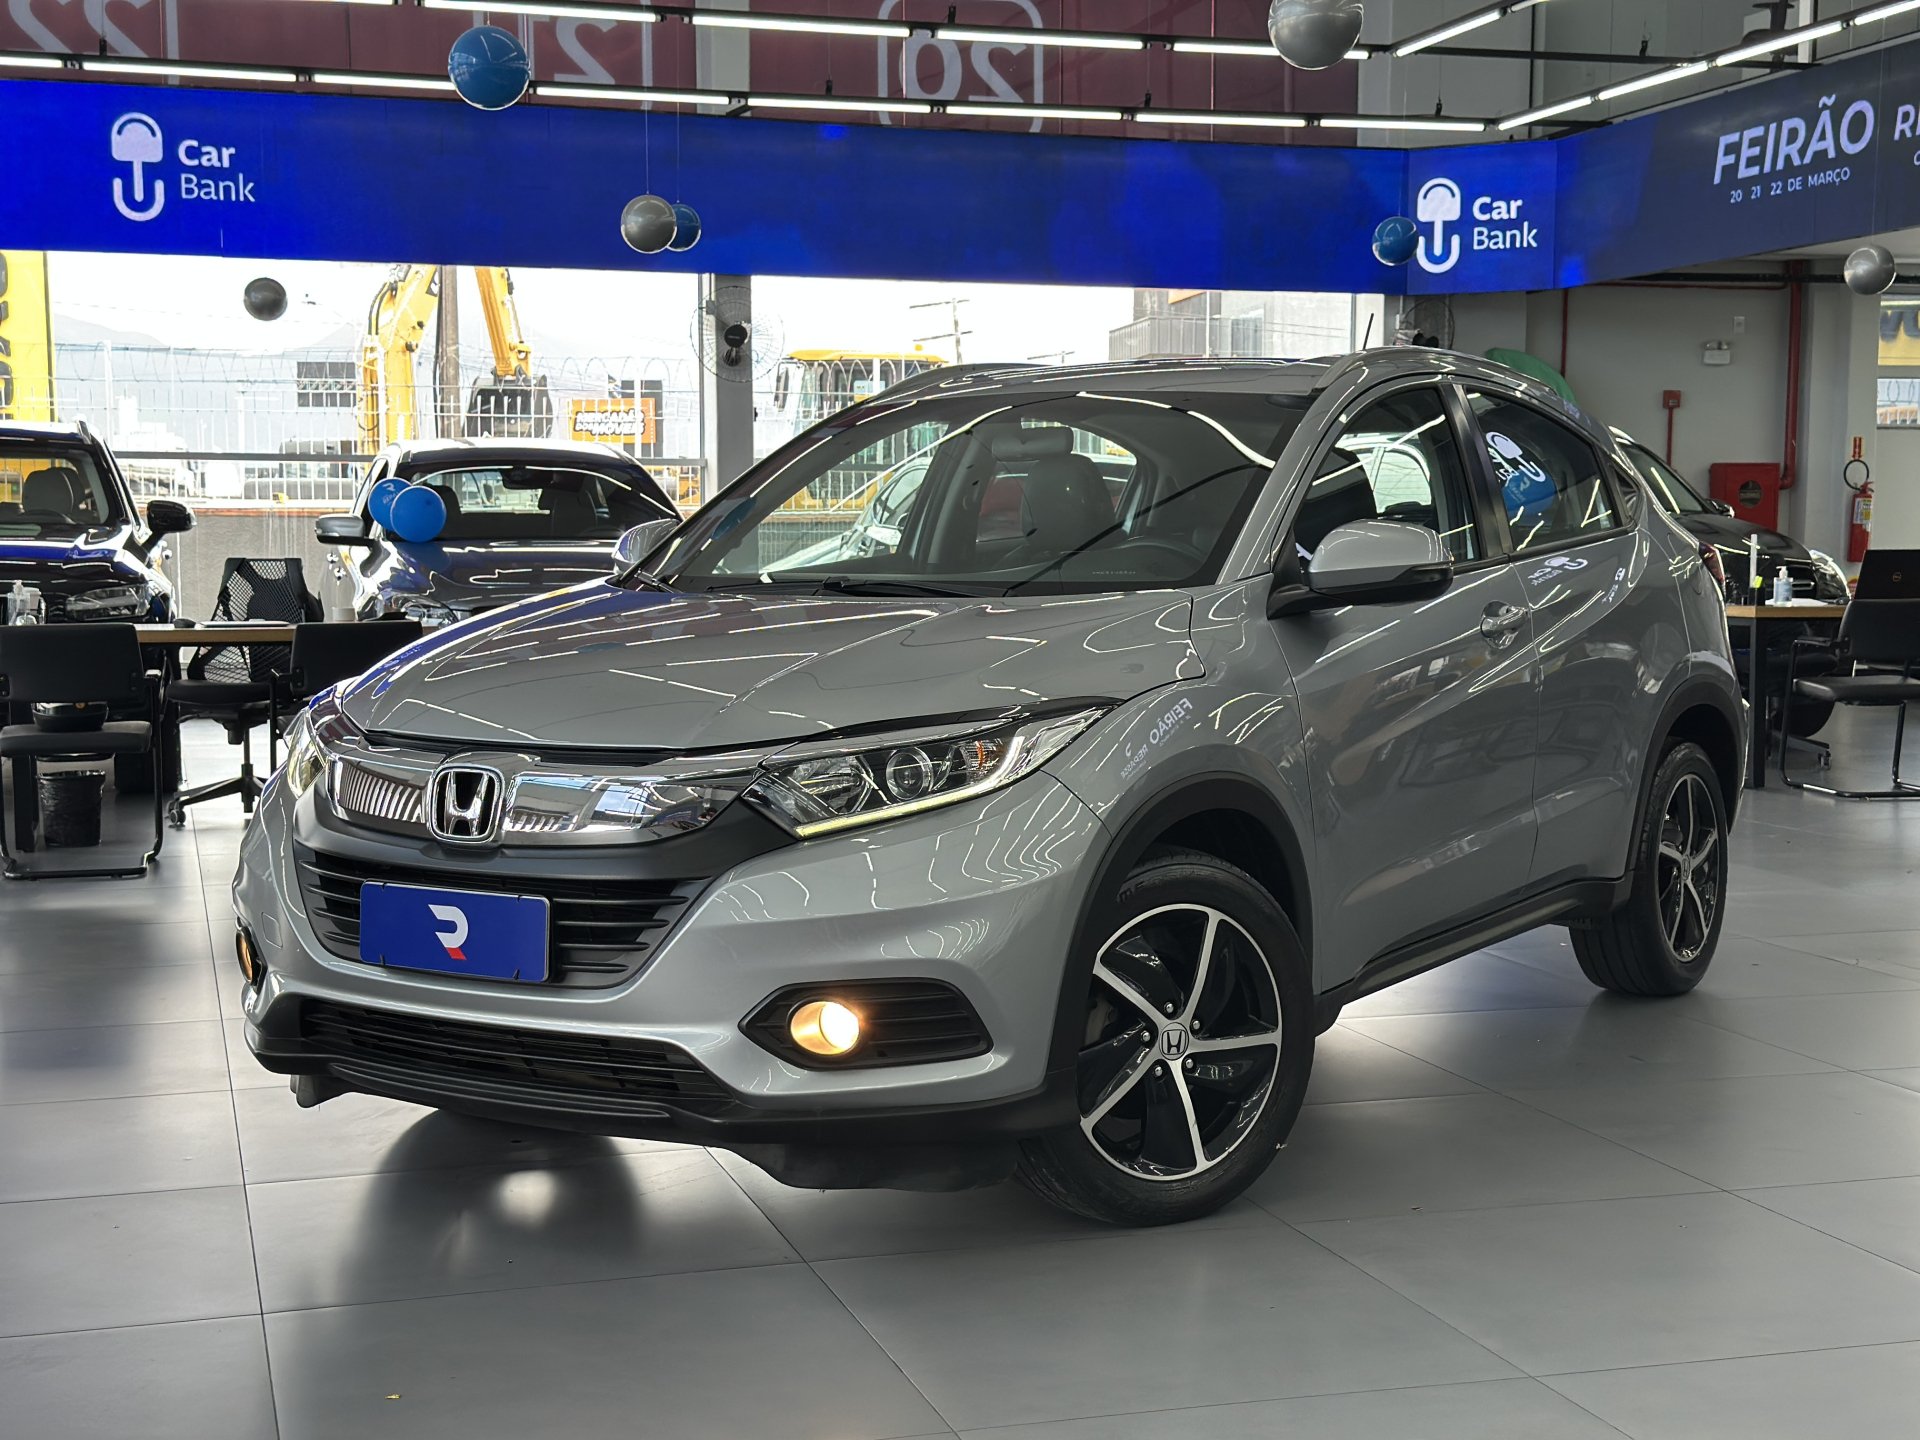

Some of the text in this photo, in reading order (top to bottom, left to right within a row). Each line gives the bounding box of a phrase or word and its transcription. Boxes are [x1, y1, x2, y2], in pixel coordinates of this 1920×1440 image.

[178, 139, 236, 168] Car
[1713, 94, 1875, 185] FEIRÃO
[180, 173, 255, 202] Bank
[1730, 167, 1850, 203] 20 21 22 DE MARÇO
[1472, 196, 1523, 221] Car
[1472, 221, 1538, 250] Bank
